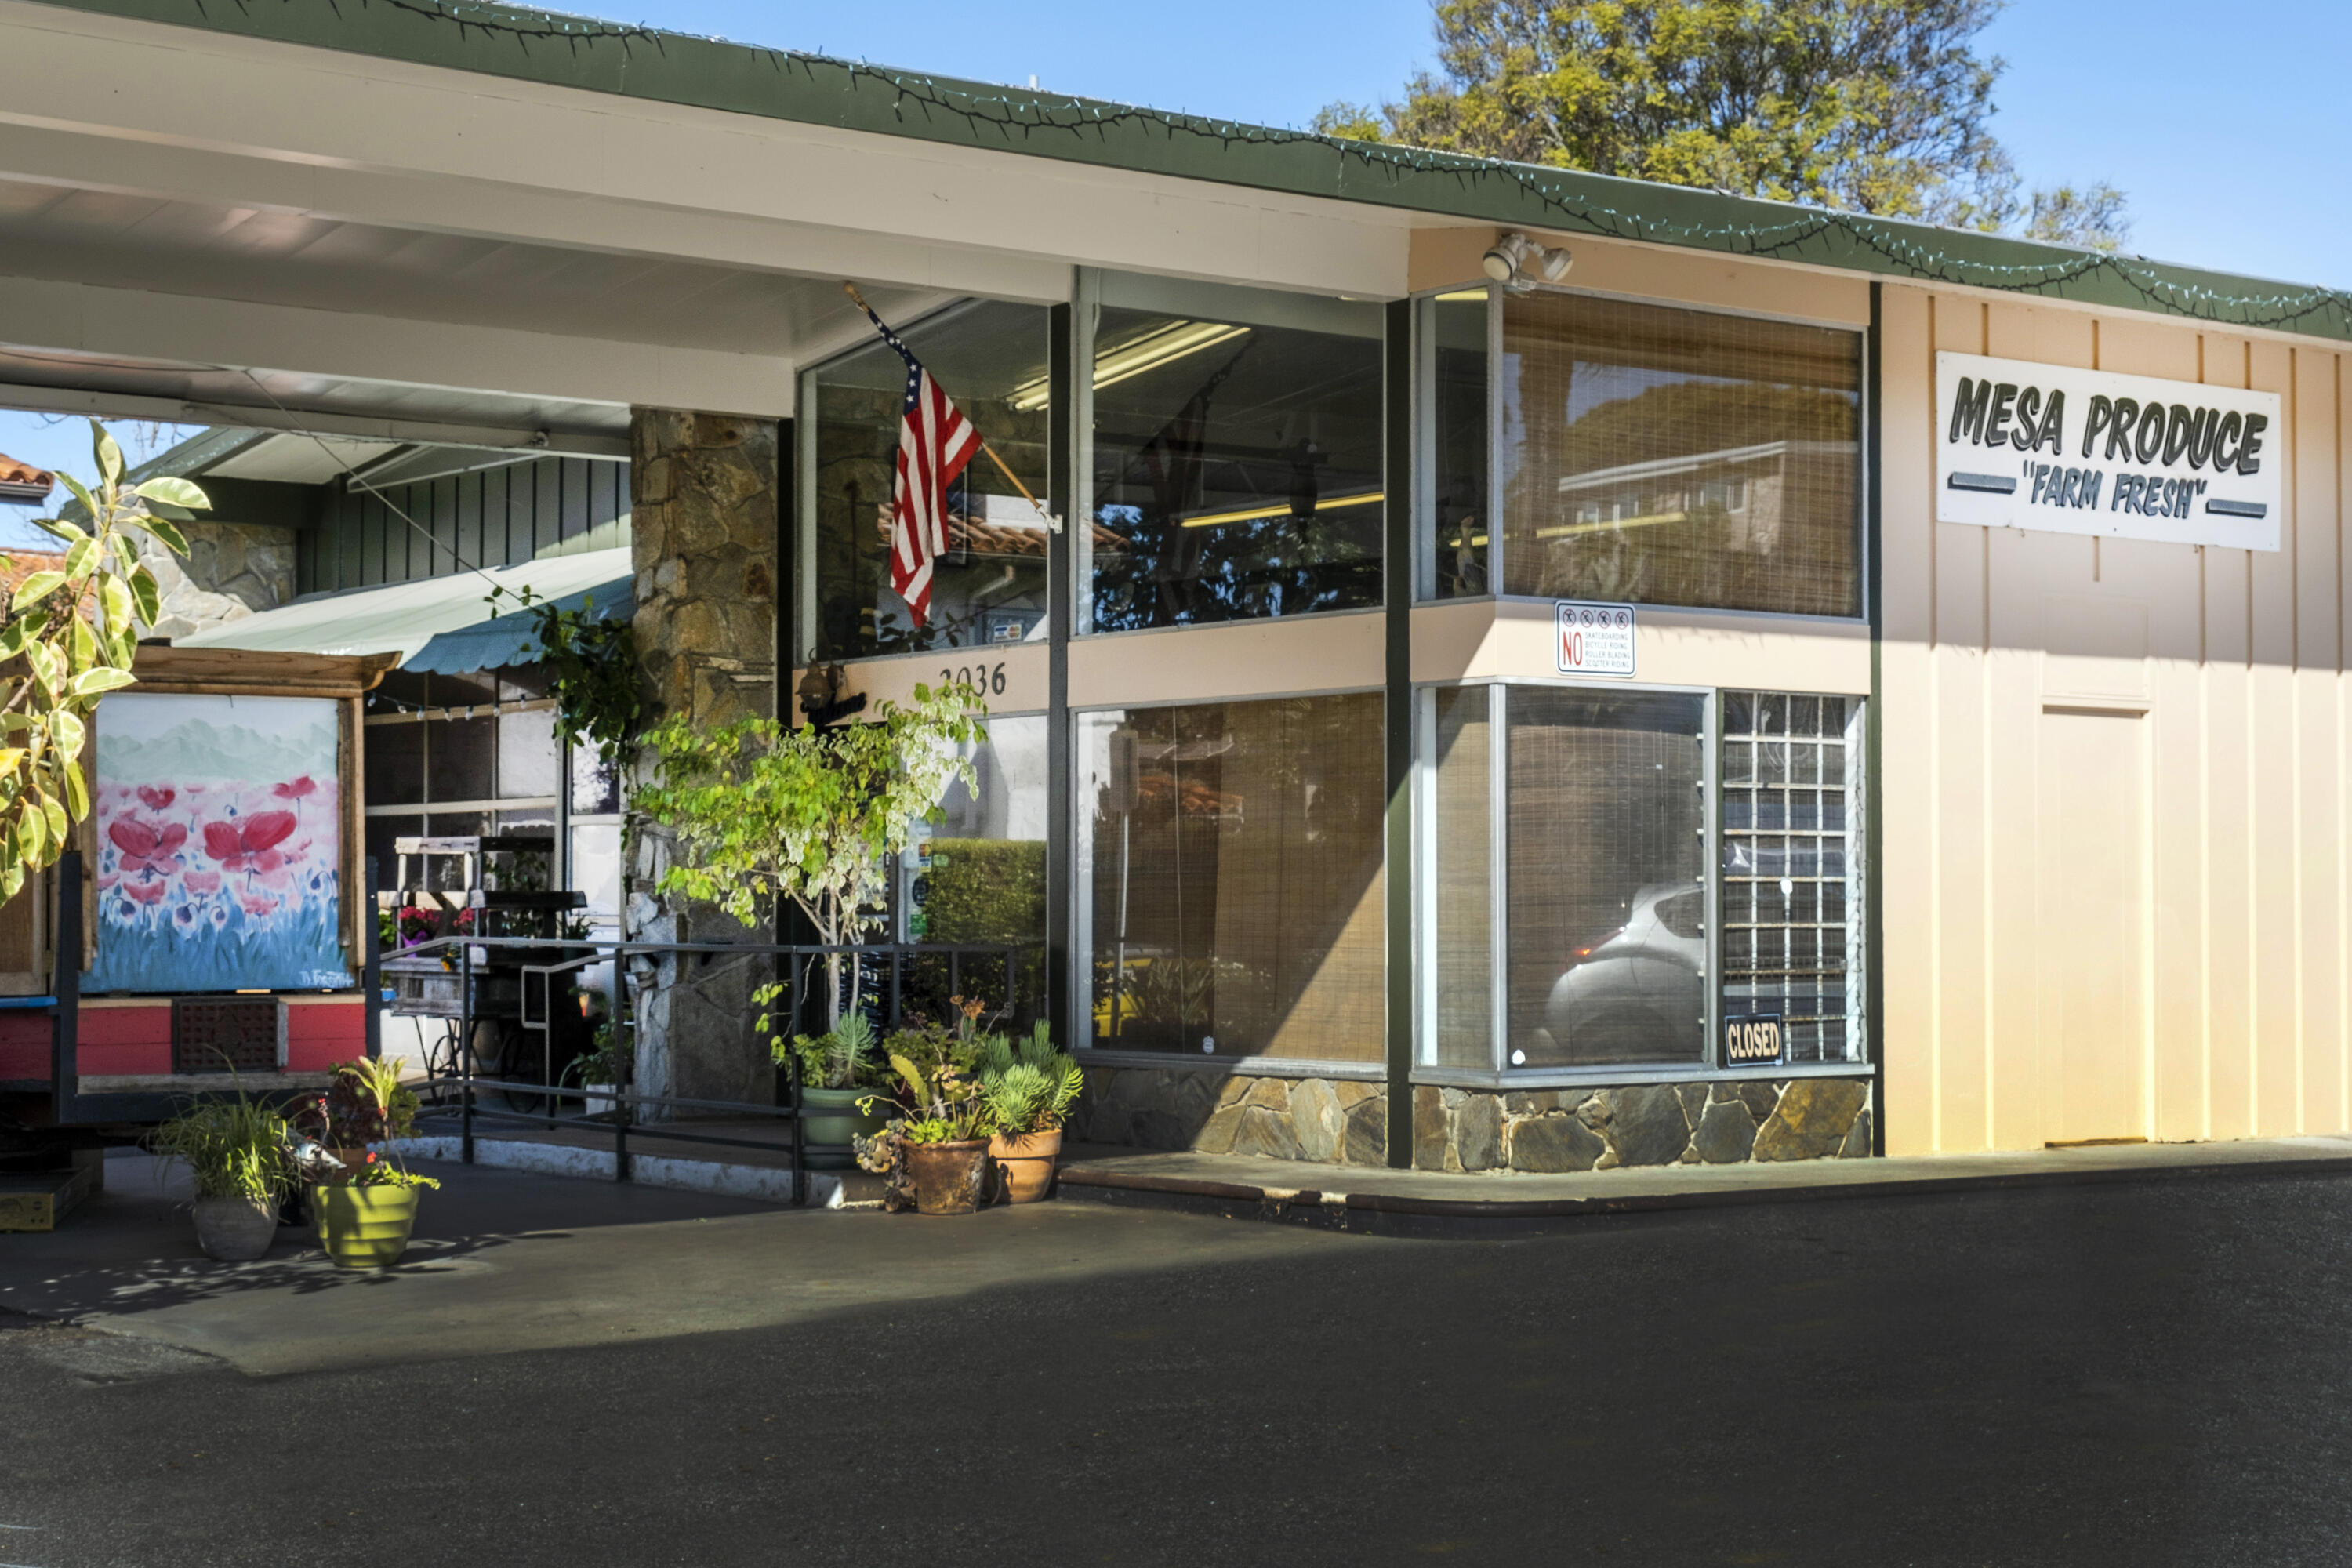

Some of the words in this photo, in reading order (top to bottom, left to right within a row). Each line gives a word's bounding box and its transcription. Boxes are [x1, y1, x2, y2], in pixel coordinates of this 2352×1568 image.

[1949, 376, 2065, 456] MESA
[2082, 394, 2268, 476] PRODUCE
[1563, 631, 1582, 666] NO
[1728, 1022, 1780, 1058] CLOSED
